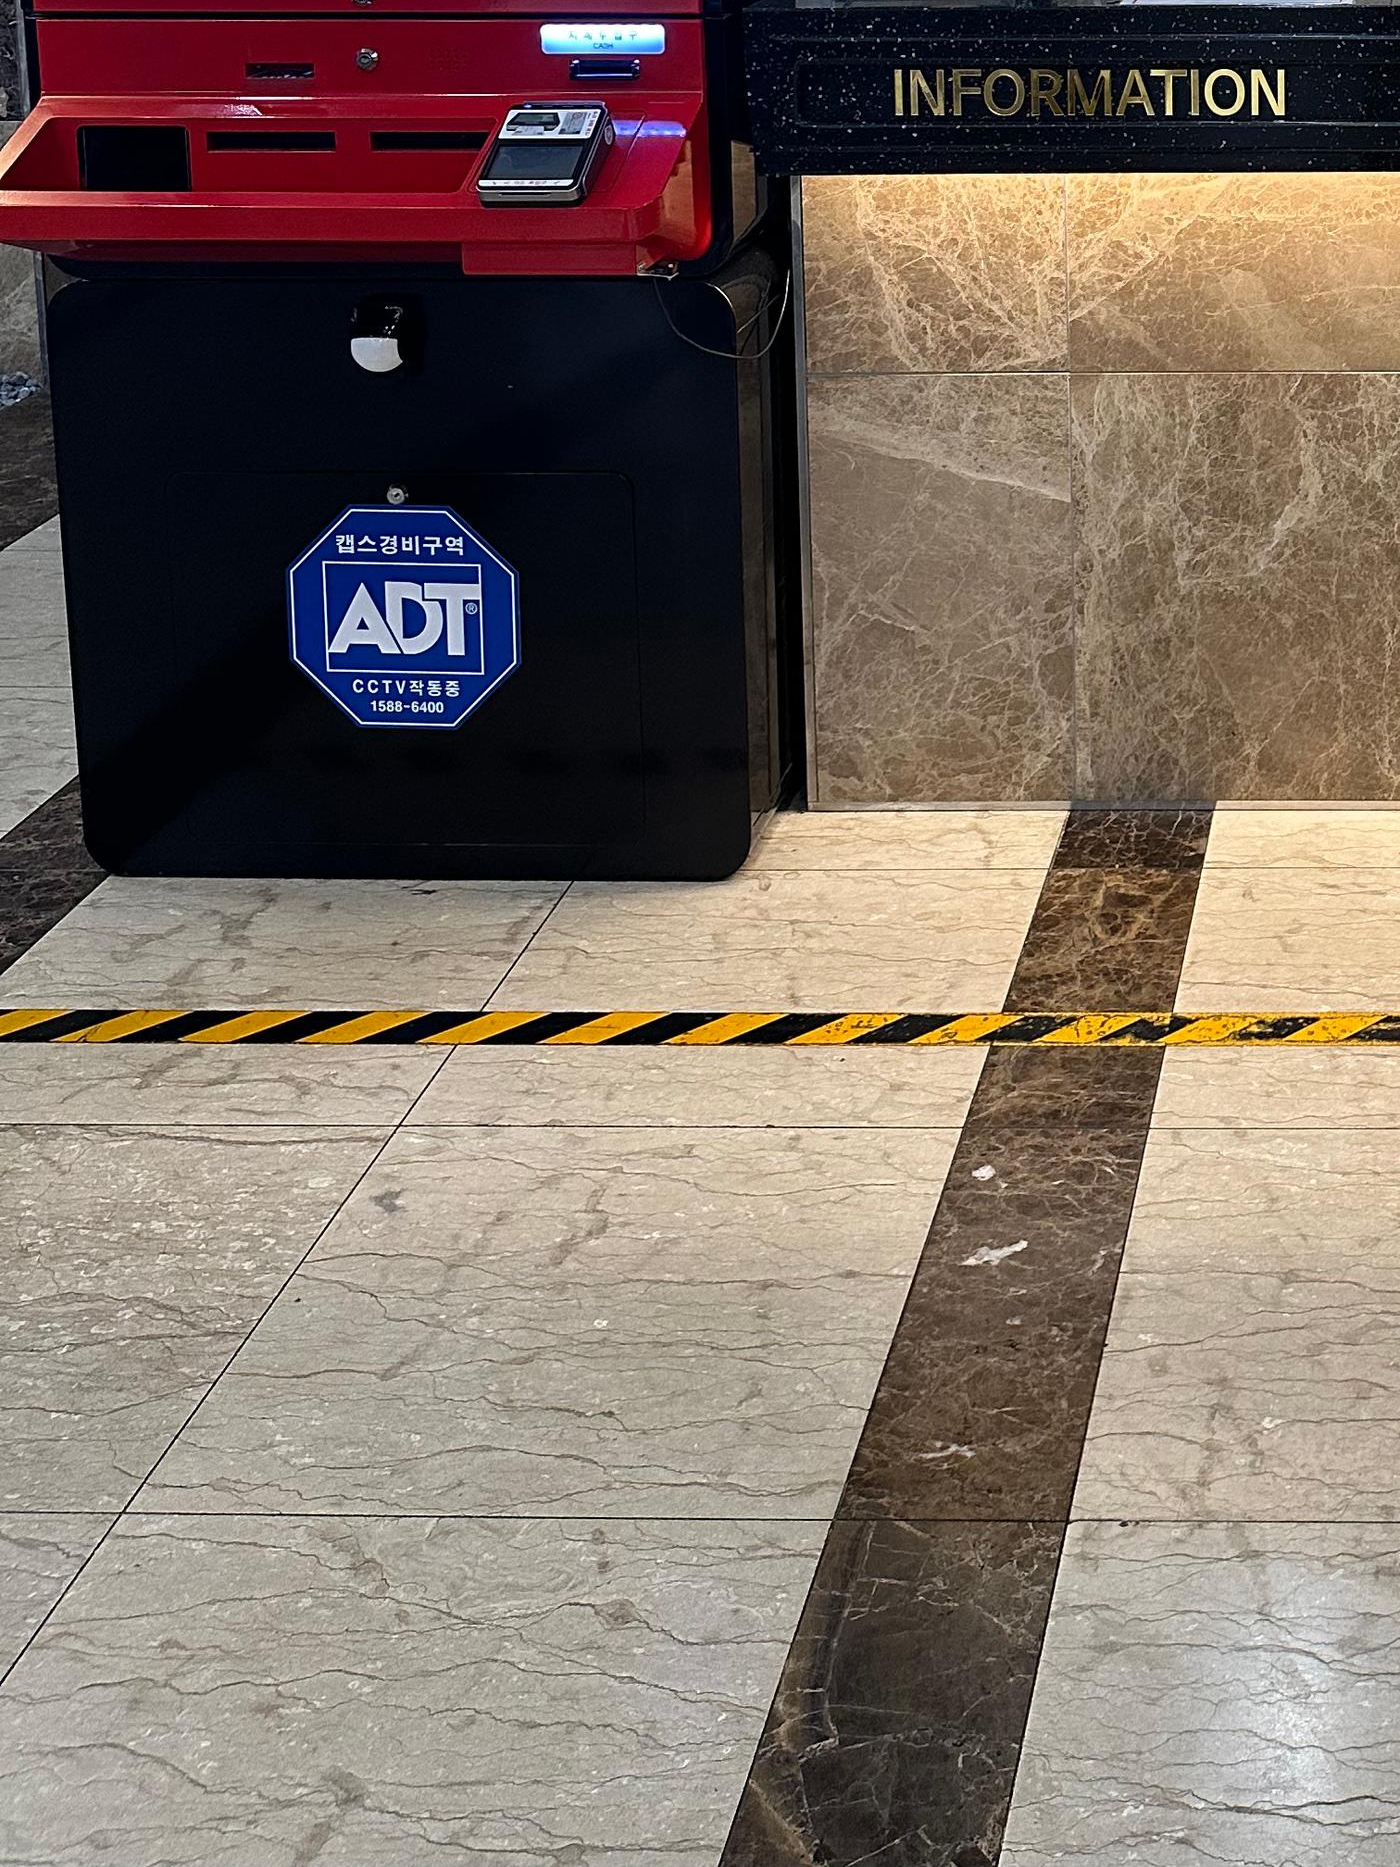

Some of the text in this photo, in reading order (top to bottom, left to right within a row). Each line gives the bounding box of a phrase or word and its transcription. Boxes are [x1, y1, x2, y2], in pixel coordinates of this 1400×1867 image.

[894, 68, 1286, 116] INFORMATION
[335, 534, 464, 556] 캡스경비구역
[327, 581, 481, 656] ADT
[352, 679, 461, 697] CCTV작동중
[370, 700, 444, 714] 1588-6400
